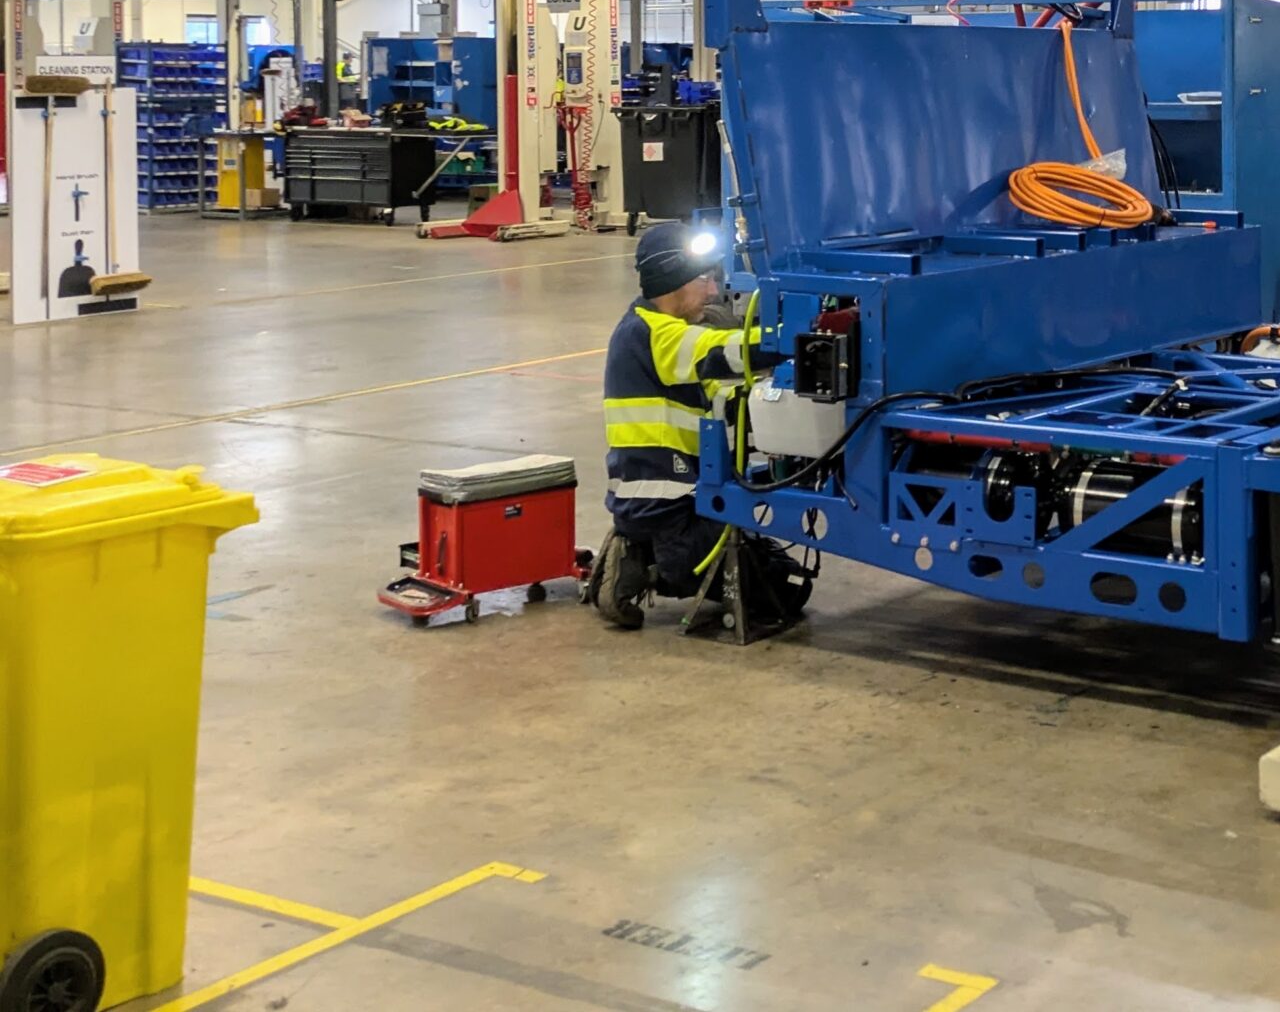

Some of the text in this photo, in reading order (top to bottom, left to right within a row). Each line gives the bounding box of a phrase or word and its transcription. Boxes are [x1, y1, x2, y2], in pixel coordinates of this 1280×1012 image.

[80, 22, 91, 35] U
[574, 16, 587, 31] U
[39, 65, 114, 76] CLEANING STATION
